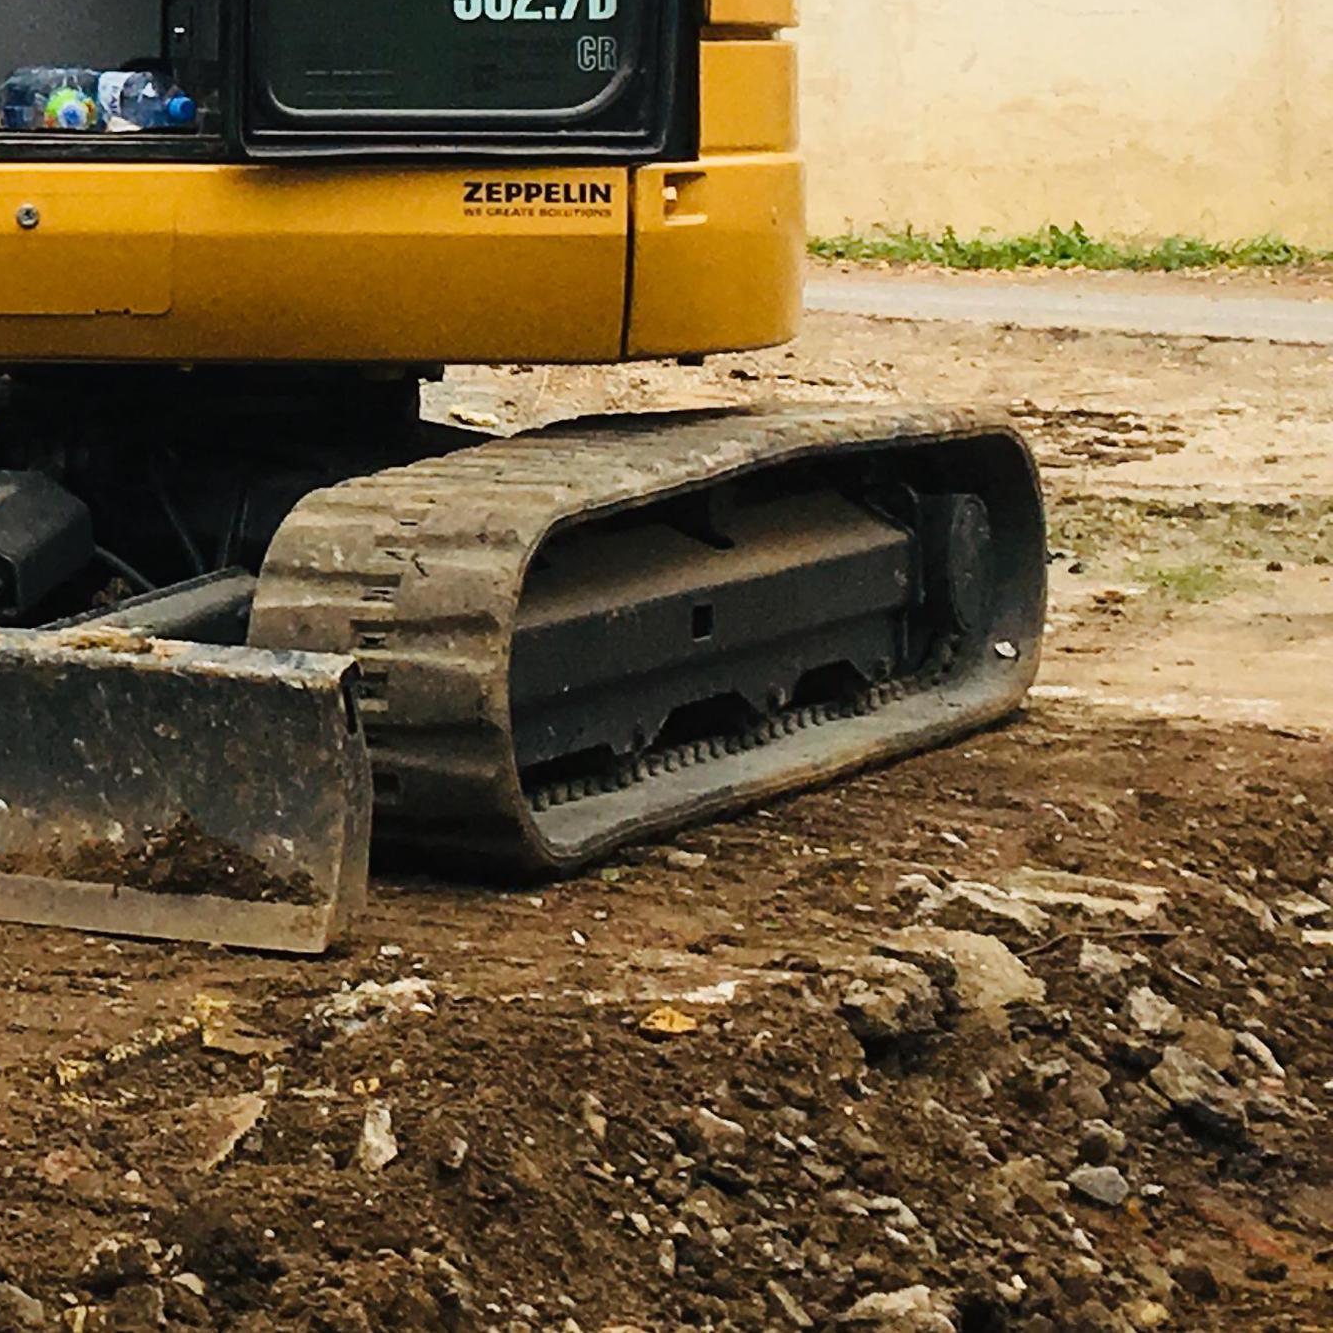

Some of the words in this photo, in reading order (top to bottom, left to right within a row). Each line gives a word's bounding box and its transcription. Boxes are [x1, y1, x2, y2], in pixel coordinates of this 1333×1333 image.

[577, 36, 617, 72] CR
[463, 181, 612, 203] ZEPPELIN
[463, 207, 482, 217] WE
[486, 207, 534, 217] CREATE
